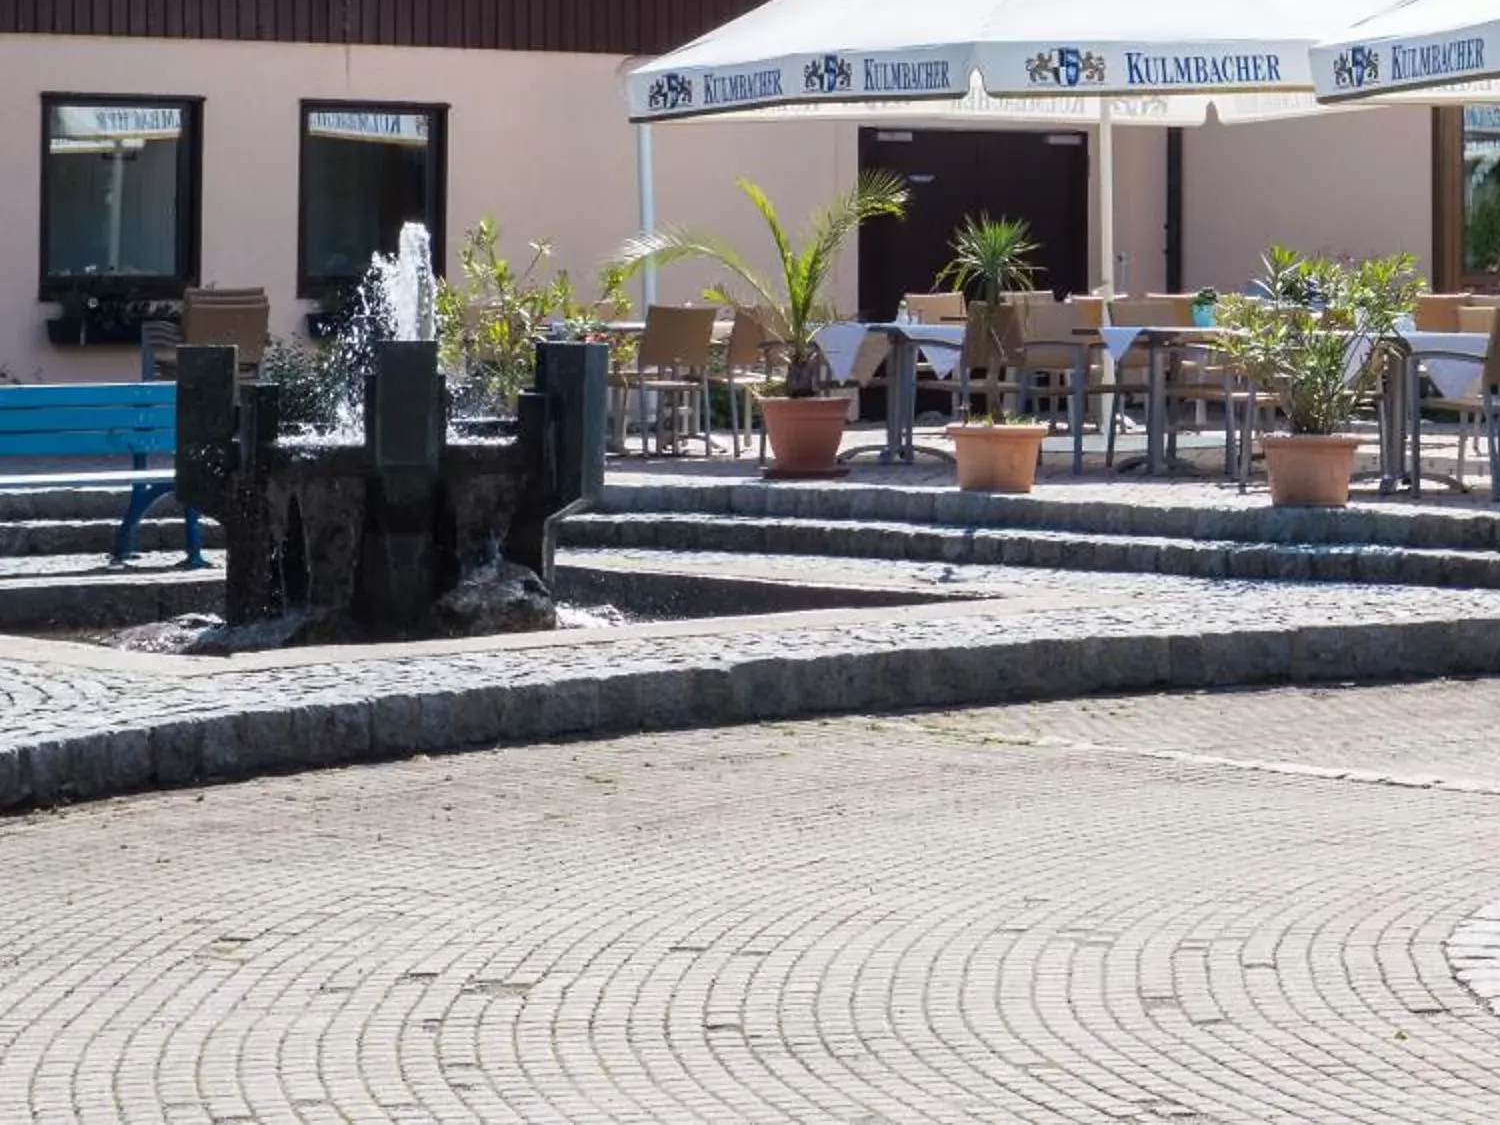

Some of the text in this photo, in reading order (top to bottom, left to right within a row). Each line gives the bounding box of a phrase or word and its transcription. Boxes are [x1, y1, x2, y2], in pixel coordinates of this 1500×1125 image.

[863, 58, 950, 90] KULMBACHER
[1125, 52, 1280, 84] KULMBACHER
[1391, 38, 1484, 80] KULMBACHER
[703, 69, 784, 104] KULMBACHER
